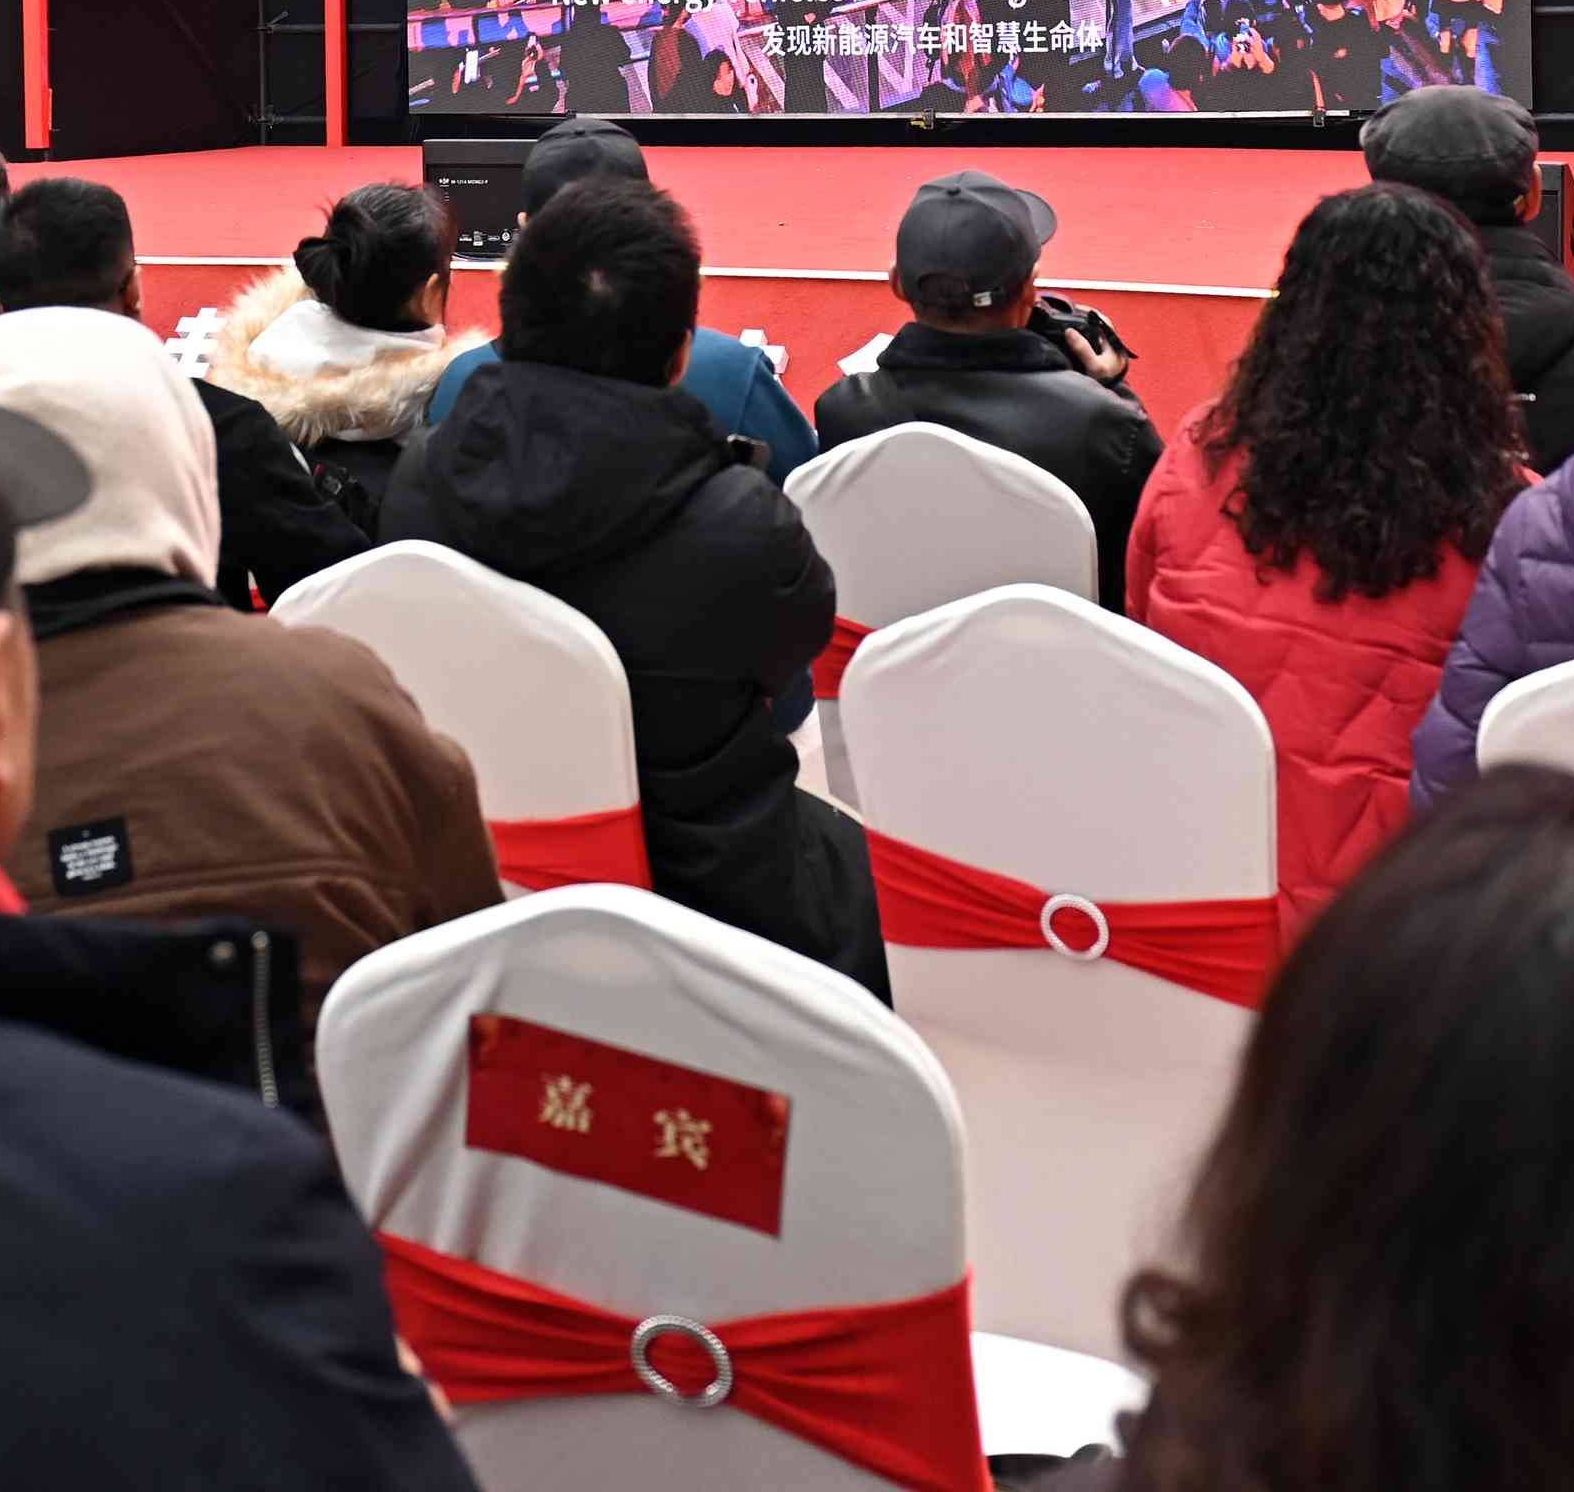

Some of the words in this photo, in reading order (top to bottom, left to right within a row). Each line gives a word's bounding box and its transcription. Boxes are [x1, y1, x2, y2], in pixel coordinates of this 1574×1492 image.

[762, 22, 1103, 57] 发现新能源汽车和智慧生命体
[540, 1073, 712, 1170] 嘉宾
